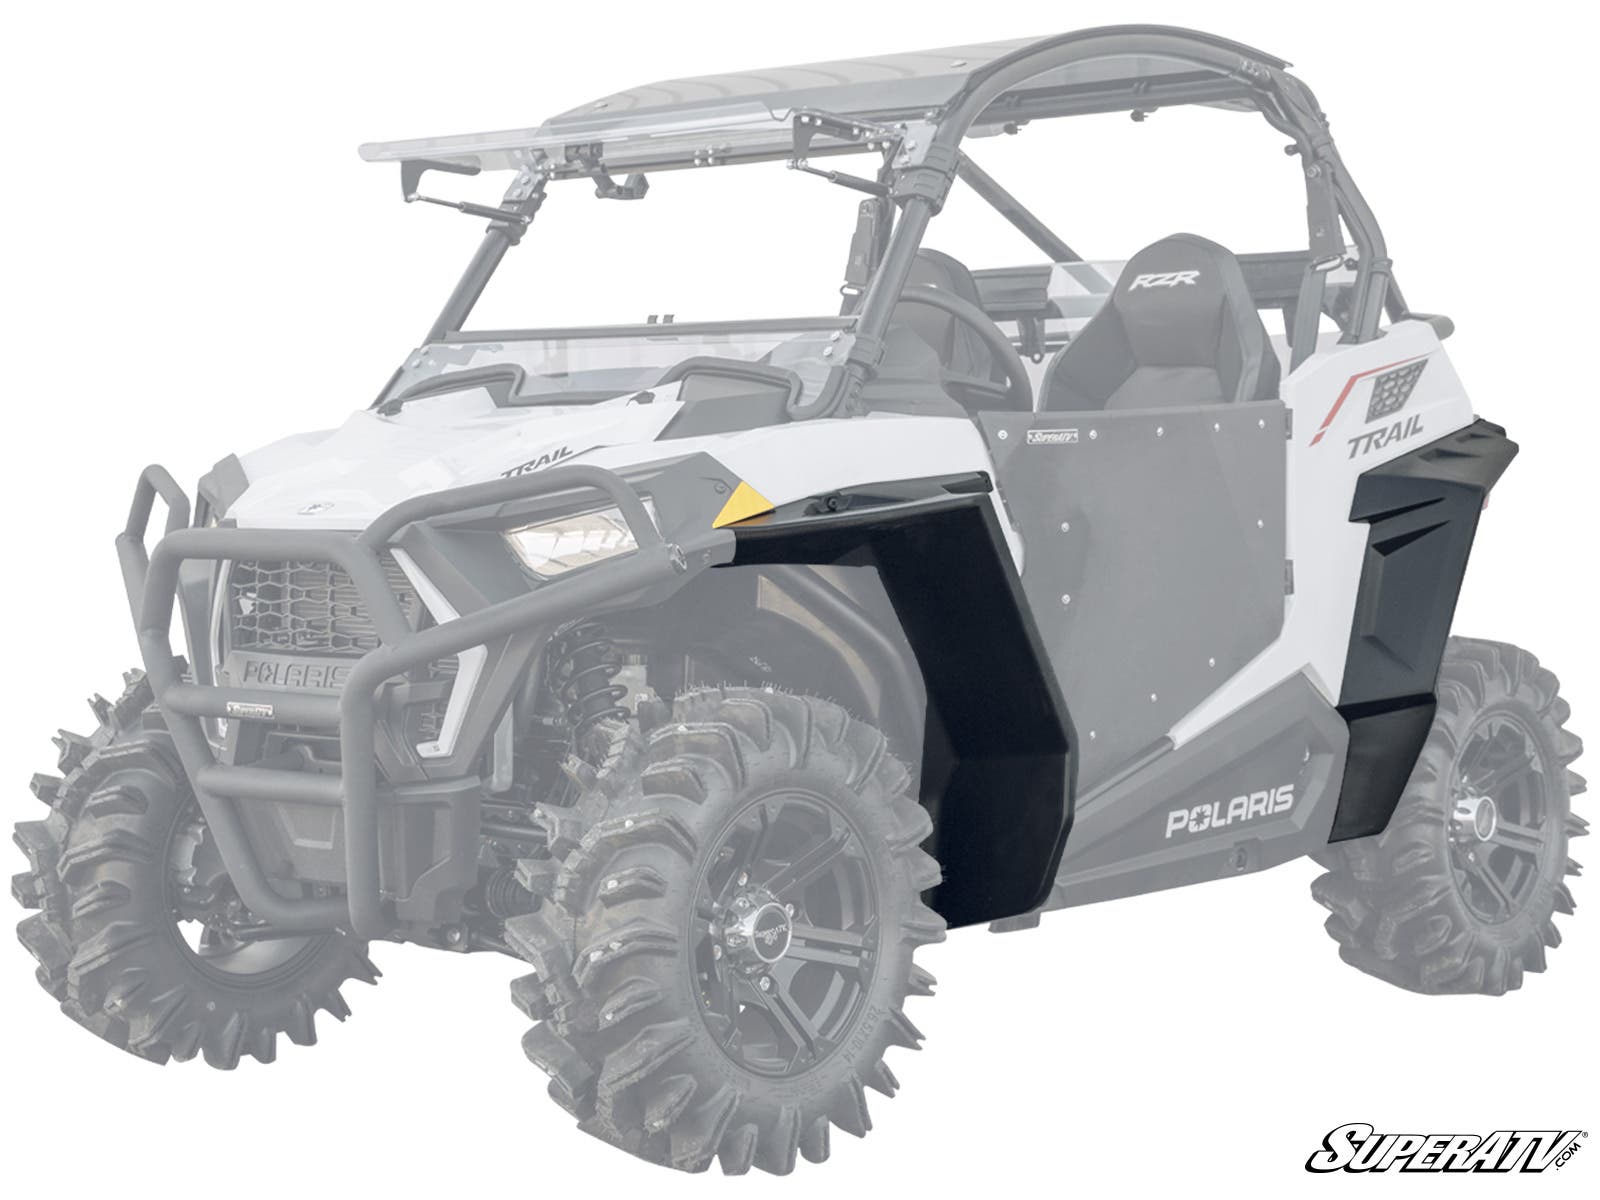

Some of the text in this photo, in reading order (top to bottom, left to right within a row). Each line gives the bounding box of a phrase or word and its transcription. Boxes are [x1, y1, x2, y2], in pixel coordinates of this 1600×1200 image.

[1128, 270, 1200, 292] RZR
[1347, 413, 1424, 460] TRAIL
[500, 446, 573, 479] TRAIL
[243, 660, 352, 690] POLARIS
[1165, 783, 1295, 839] POLARIS
